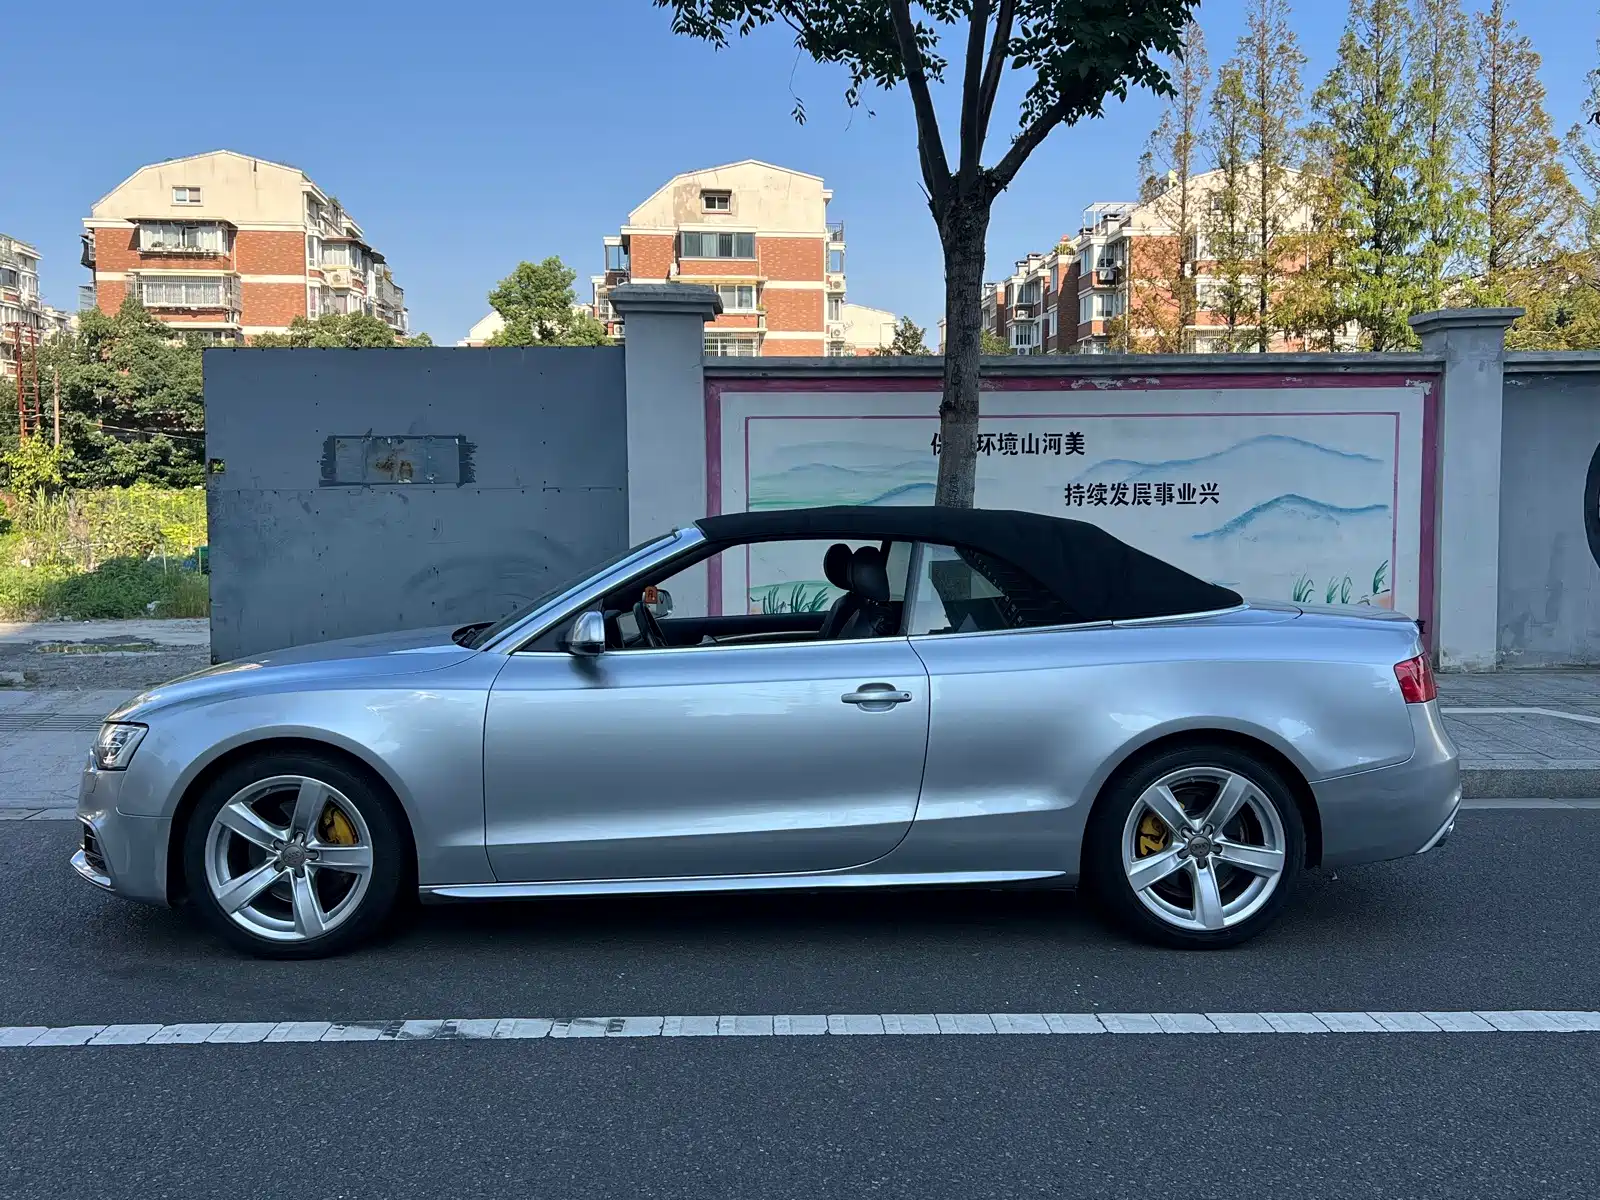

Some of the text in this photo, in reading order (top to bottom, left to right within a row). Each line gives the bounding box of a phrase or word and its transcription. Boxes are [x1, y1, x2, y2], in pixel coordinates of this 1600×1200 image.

[930, 432, 1085, 456] 环境山河美
[1064, 482, 1220, 506] 持续发展事业兴
